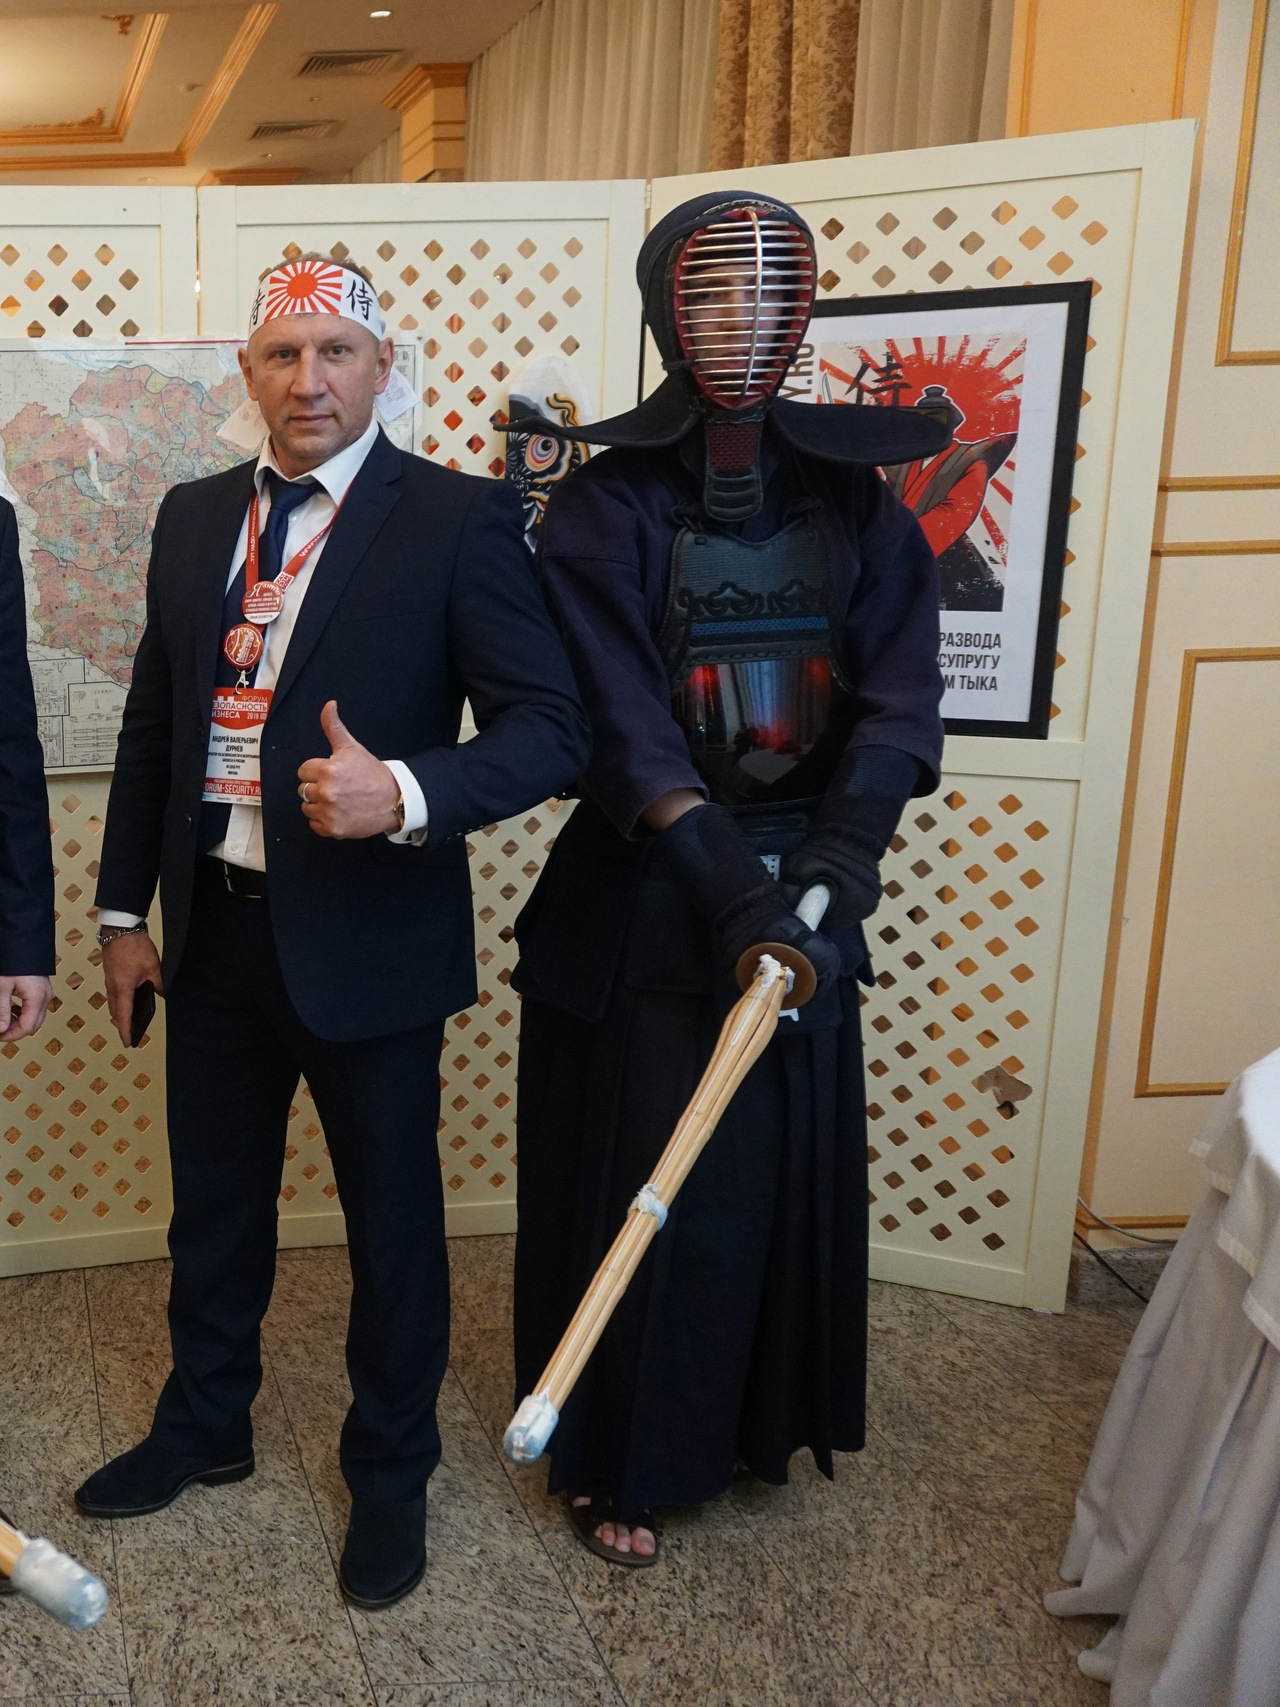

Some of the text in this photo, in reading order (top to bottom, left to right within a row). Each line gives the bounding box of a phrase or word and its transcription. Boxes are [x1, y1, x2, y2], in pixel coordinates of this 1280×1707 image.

[346, 279, 374, 321] 侍
[939, 632, 1002, 650] РАЗВОДА
[939, 653, 1001, 669] СУПРУГУ
[959, 674, 998, 691] ТЫКА
[213, 701, 267, 711] ЕЗОПАСНОСТЬ
[242, 695, 268, 703] ФОРУМ
[211, 710, 260, 720] ИЗНЕСА 2019
[212, 735, 259, 744] АНДРЕЙ ВАЛЕРЬЕВИЧ
[205, 782, 261, 796] ORUM-SECURITY.R
